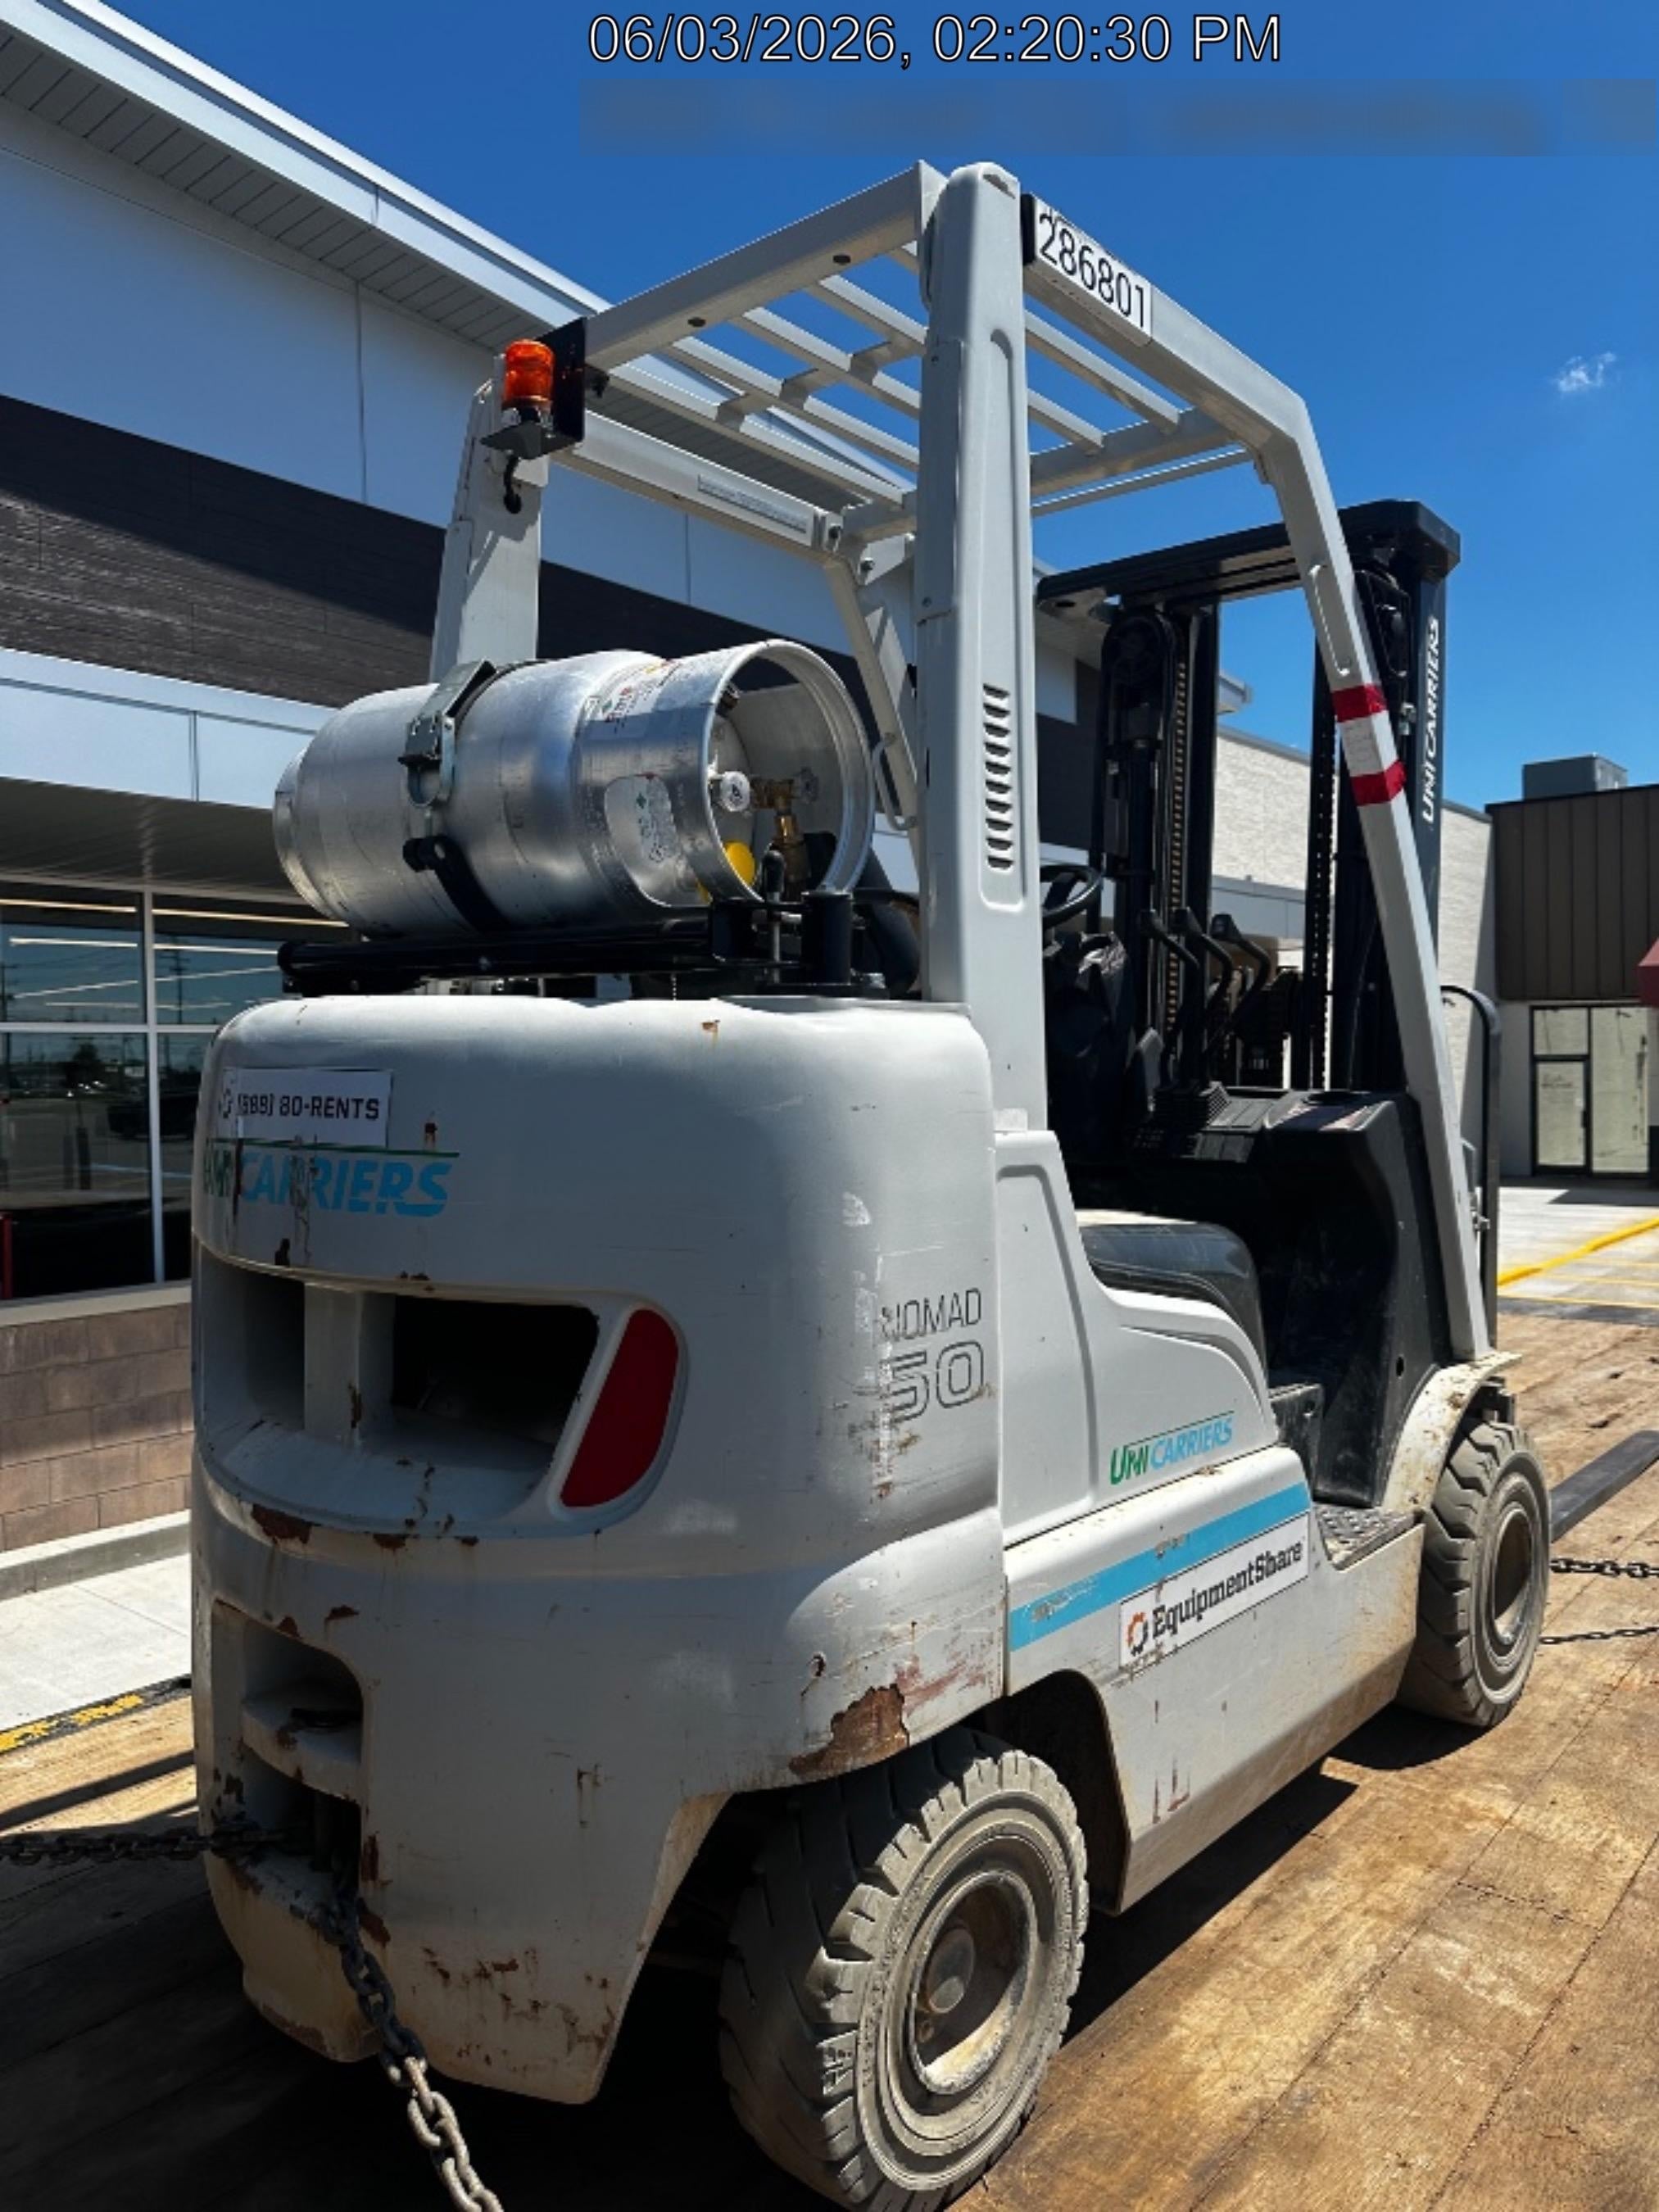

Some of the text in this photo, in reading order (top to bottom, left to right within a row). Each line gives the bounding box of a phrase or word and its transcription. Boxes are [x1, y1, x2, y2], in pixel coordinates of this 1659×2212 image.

[1039, 212, 1145, 329] 286801
[1422, 615, 1439, 823] UNICARRIERS
[279, 1095, 380, 1120] 80-RENTS
[882, 1288, 981, 1341] NOMAD
[882, 1340, 985, 1424] 50
[1153, 1540, 1303, 1639] EquipmentShare
